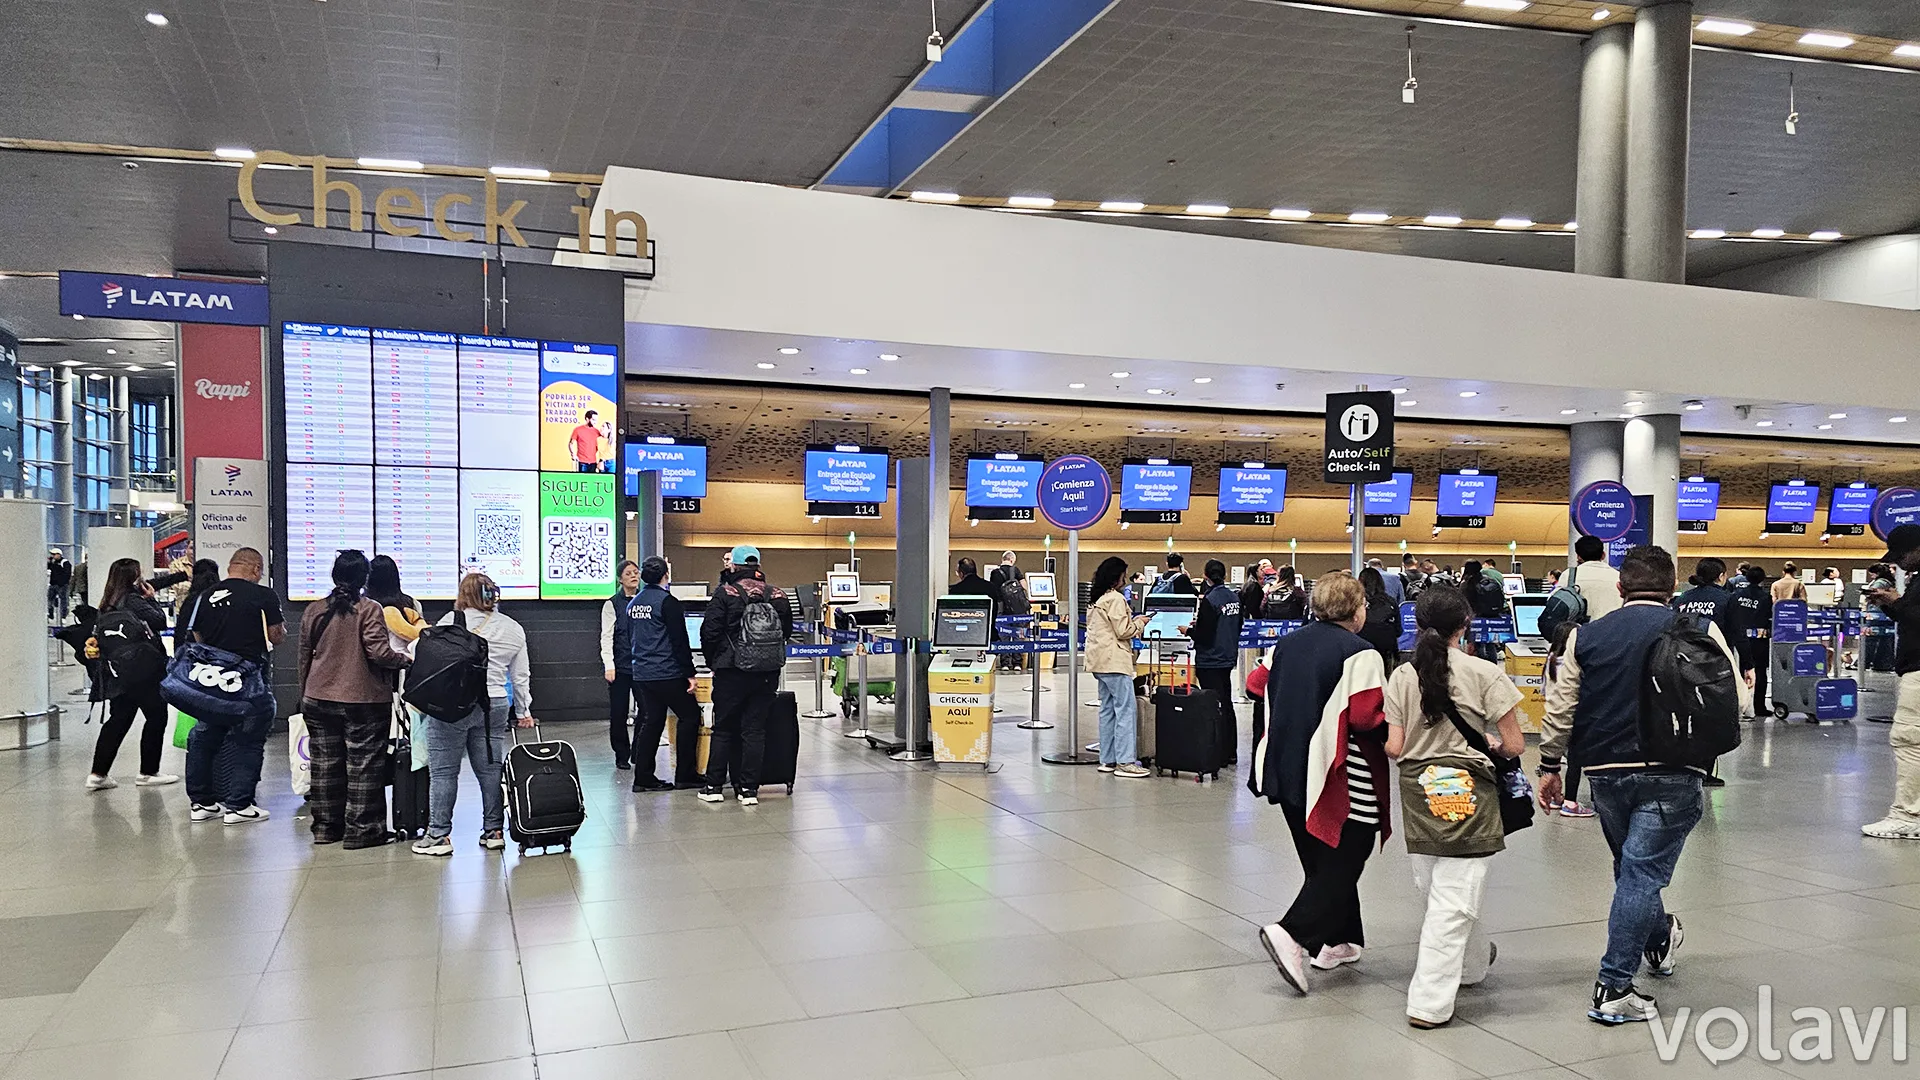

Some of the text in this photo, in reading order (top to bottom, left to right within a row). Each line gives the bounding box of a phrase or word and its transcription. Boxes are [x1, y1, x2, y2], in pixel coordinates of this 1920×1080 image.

[237, 150, 649, 259] Check in
[130, 289, 234, 310] LATAM
[383, 330, 419, 342] Embarque
[420, 332, 449, 342] Terminal
[462, 336, 491, 347] Boarding
[492, 338, 510, 348] Gates
[512, 340, 538, 349] Terminal
[194, 378, 251, 401] Rappi
[545, 408, 577, 416] TRABAJO
[648, 452, 684, 460] LATAM
[1328, 447, 1390, 459] Auto/Self
[836, 460, 867, 468] LATAM
[994, 464, 1025, 472] LATAM
[1328, 461, 1380, 472] Check-in
[662, 468, 696, 476] Especiales
[818, 470, 840, 478] Entrega
[850, 472, 876, 480] Equipaje
[542, 480, 613, 493] SIGUE TU
[981, 479, 1000, 487] Entrega
[1008, 480, 1028, 488] Equipaje
[1052, 480, 1094, 492] ¡Comienza
[1062, 490, 1085, 502] Aquí!
[552, 495, 604, 507] VUELO
[672, 501, 695, 510] 115
[1588, 501, 1624, 510] ¡Comienza
[855, 505, 875, 514] 114
[1011, 510, 1030, 518] 113
[202, 514, 247, 522] Oficina de
[1160, 513, 1177, 521] 112
[1254, 515, 1271, 523] 111
[1597, 511, 1615, 519] Aquí!
[1383, 517, 1397, 525] 110
[947, 708, 971, 716] AQUÍ
